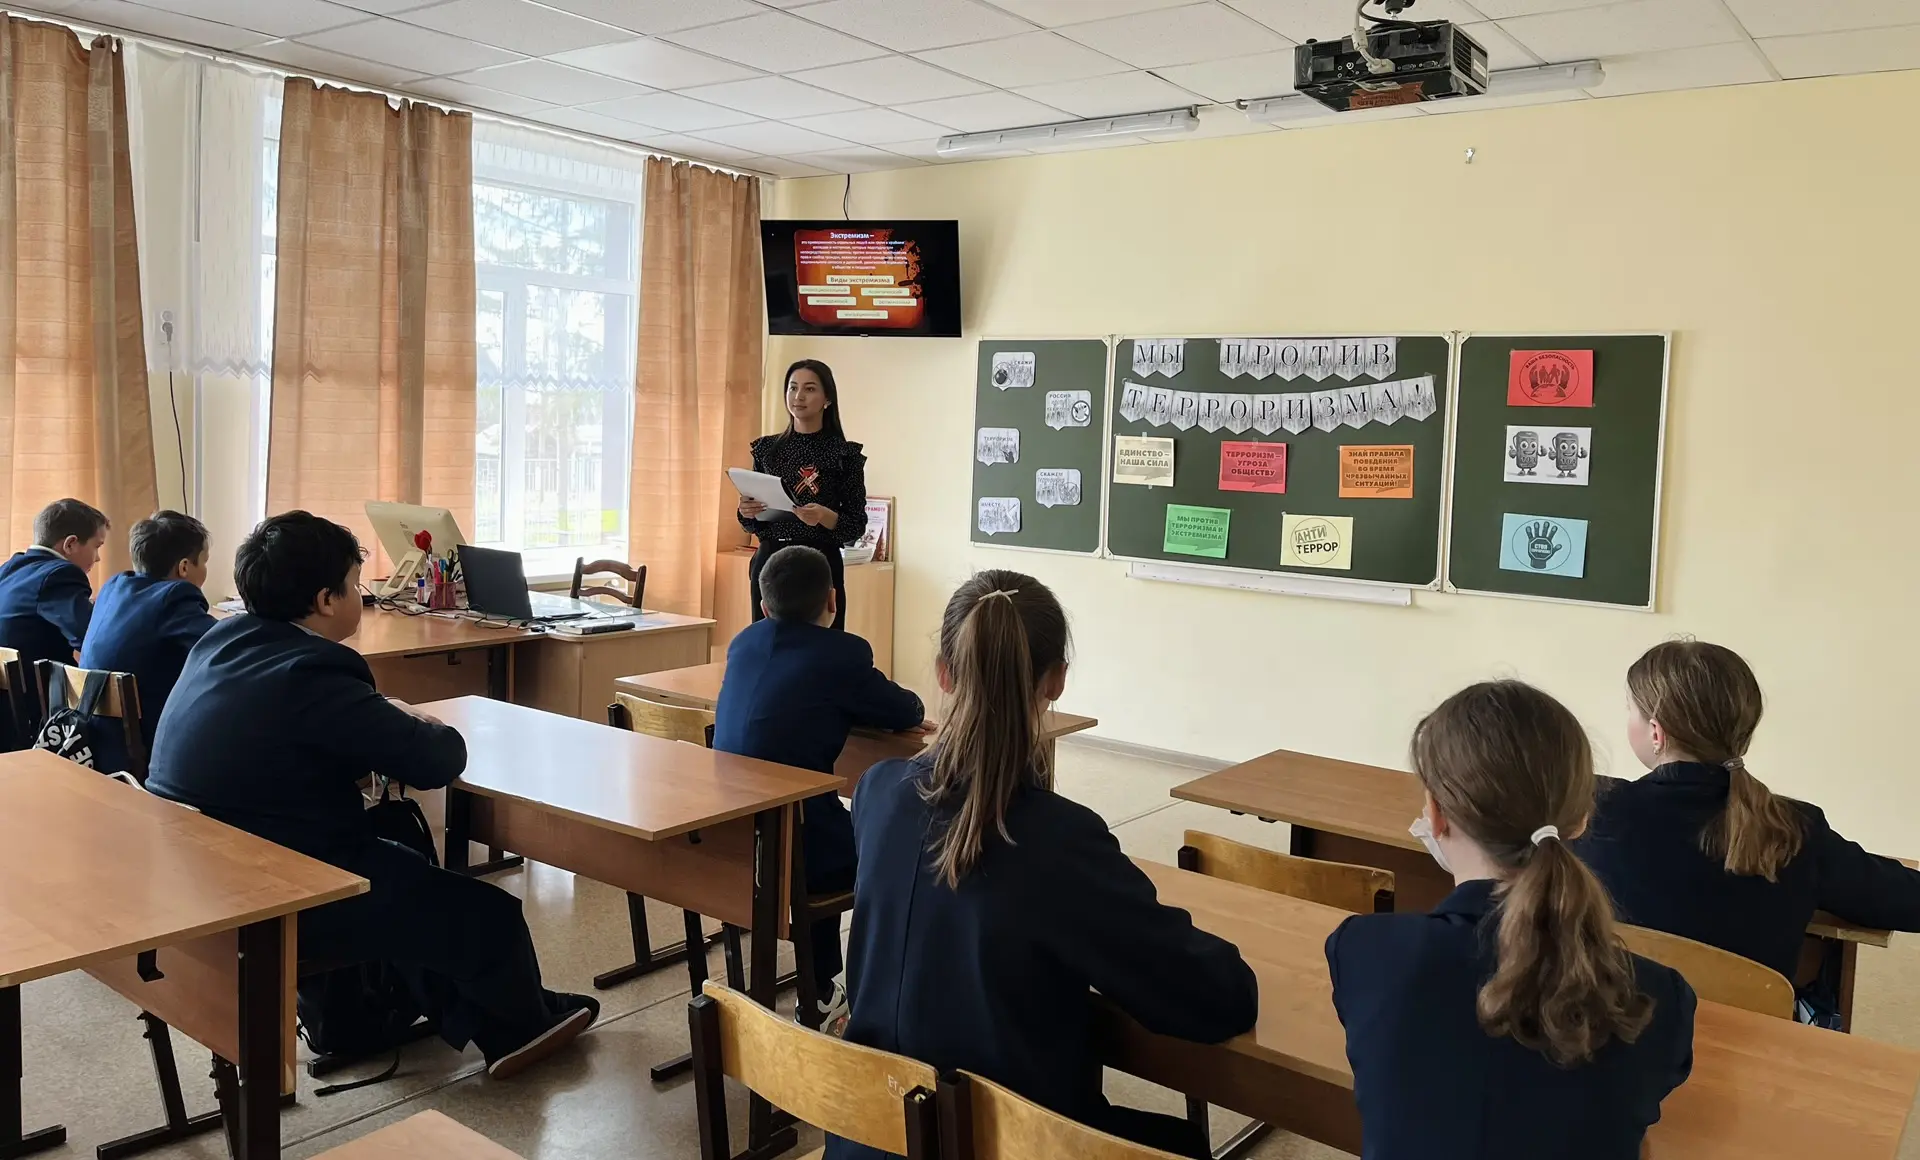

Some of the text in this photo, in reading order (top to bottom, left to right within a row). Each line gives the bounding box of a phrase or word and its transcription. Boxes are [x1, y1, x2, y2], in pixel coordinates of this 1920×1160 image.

[830, 232, 869, 240] Экстремизм
[1136, 343, 1391, 367] МЫ ПРОТИВ
[1119, 449, 1163, 458] ЕДИНСТВО
[1226, 451, 1275, 460] ТЕРРОРИЗМ
[1348, 449, 1369, 457] ЗНАЙ
[1120, 458, 1169, 468] НАША СИЛА
[1237, 460, 1268, 468] УГРОЗА
[1231, 468, 1275, 477] ОБЩЕСТВУ
[1177, 515, 1190, 523] МЫ
[1296, 525, 1327, 544] АНТИ
[1296, 541, 1339, 554] ТЕРРОР
